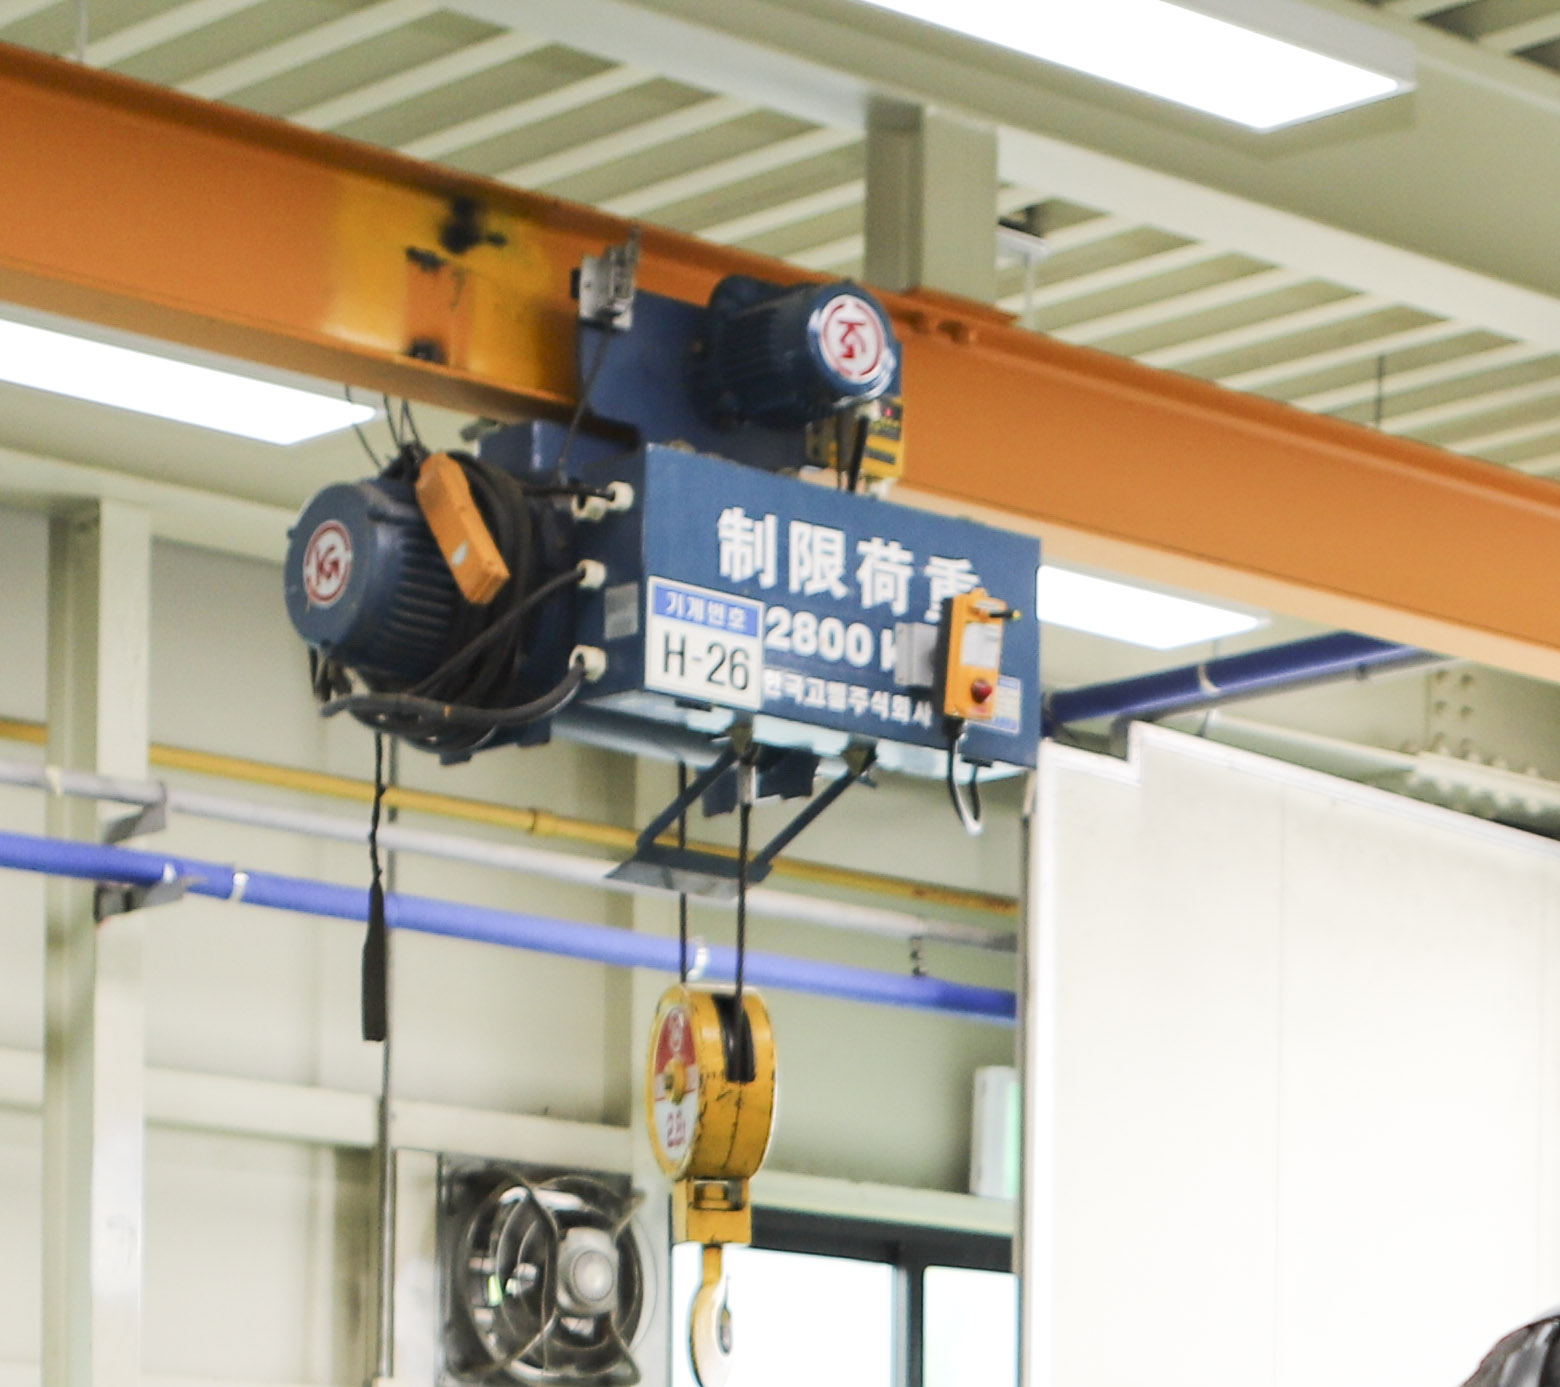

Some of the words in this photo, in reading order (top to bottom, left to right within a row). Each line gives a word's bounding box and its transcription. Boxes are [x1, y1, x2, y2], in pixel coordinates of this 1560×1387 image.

[666, 590, 748, 631] 기계번호
[765, 605, 874, 668] 2800
[662, 631, 750, 692] H-26
